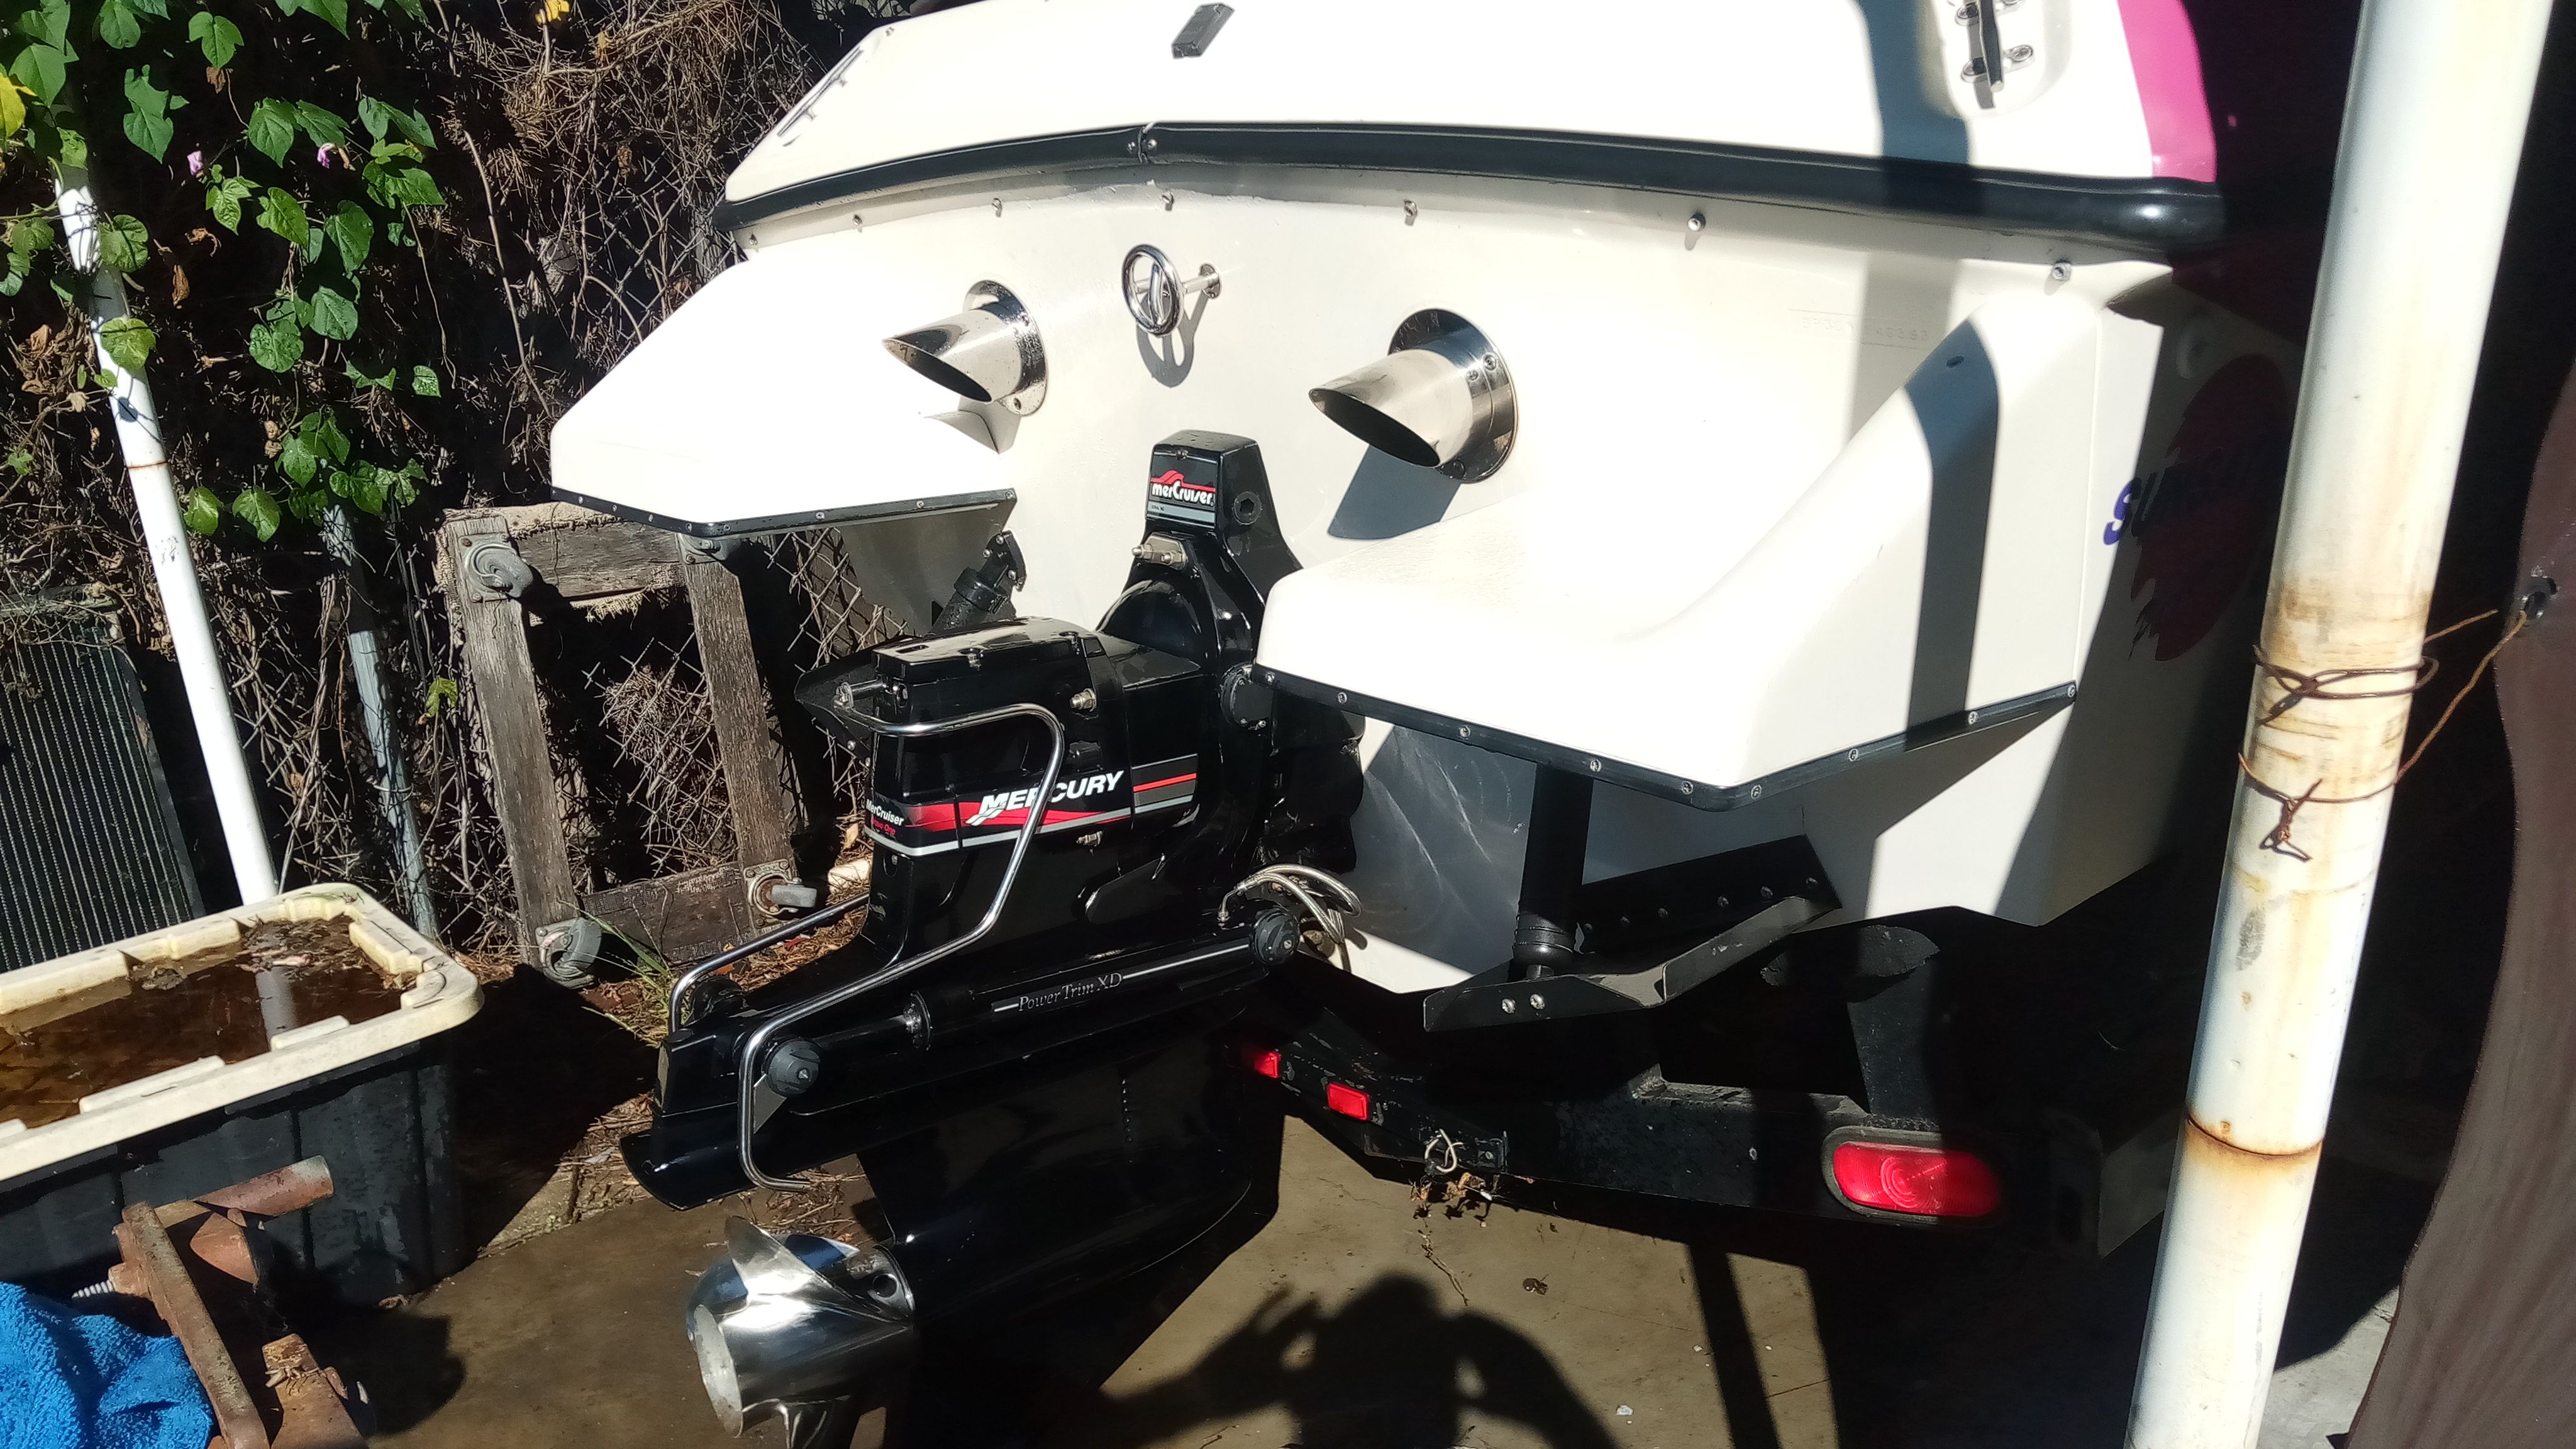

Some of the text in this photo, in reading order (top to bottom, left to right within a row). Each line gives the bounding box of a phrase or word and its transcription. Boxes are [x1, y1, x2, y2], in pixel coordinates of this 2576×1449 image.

[1152, 480, 1213, 505] merCruiser
[977, 770, 1124, 816] MERCURY
[866, 799, 904, 826] MerCruiser
[1018, 972, 1123, 1012] Power Trim XD
